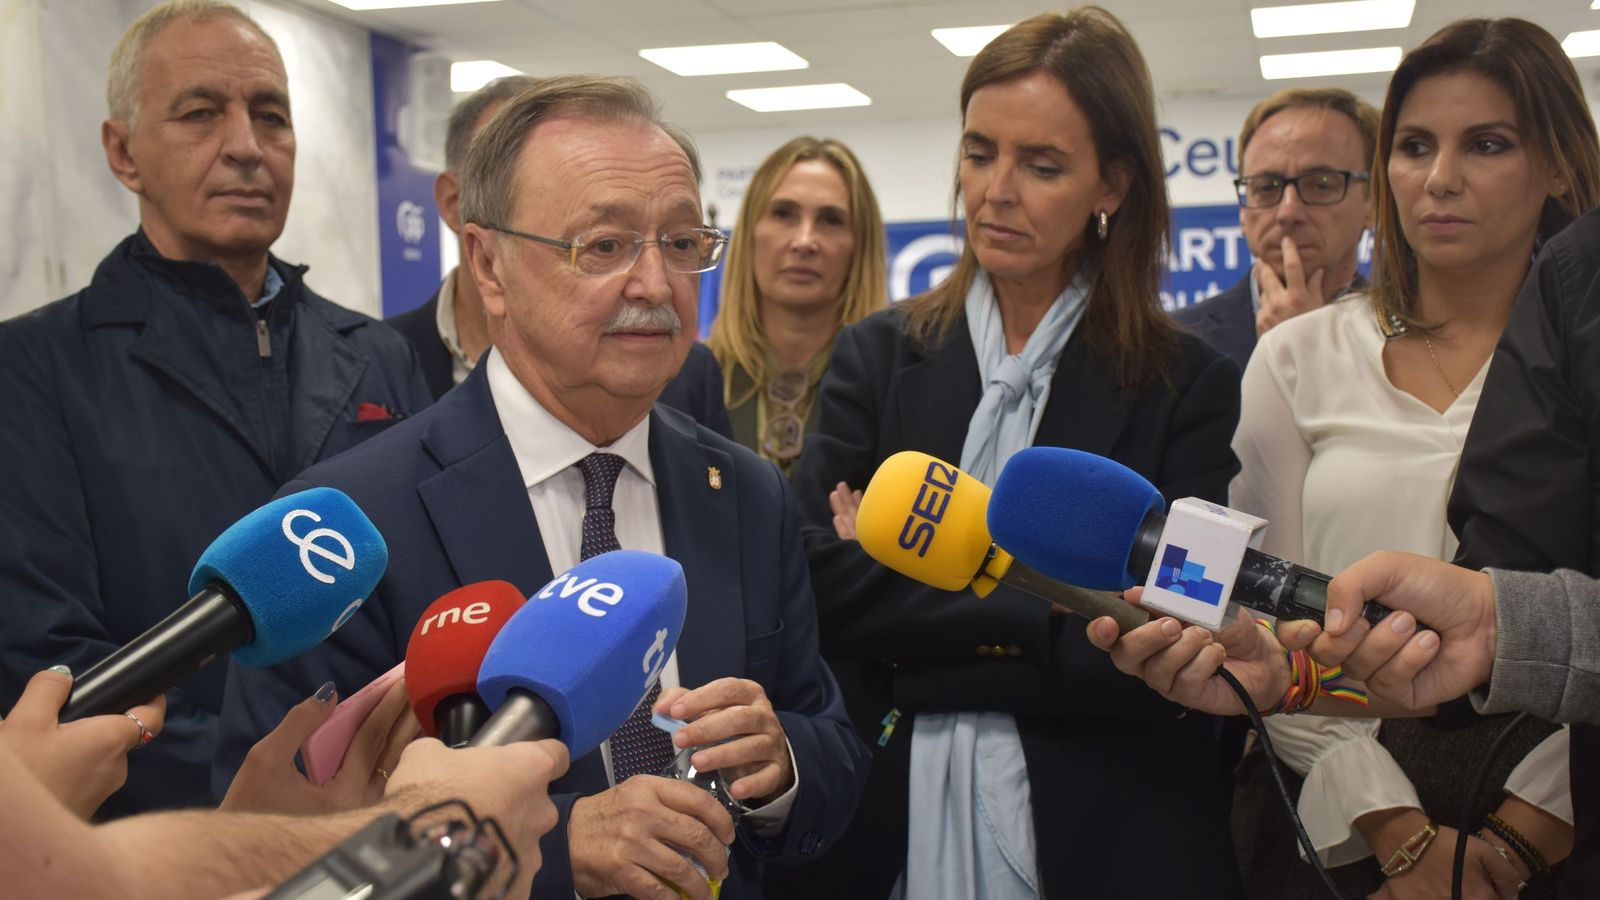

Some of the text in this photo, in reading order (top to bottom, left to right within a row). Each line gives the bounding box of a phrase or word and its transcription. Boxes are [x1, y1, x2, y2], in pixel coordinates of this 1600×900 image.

[898, 461, 959, 558] SER
[538, 572, 624, 618] tve
[420, 601, 491, 636] rne
